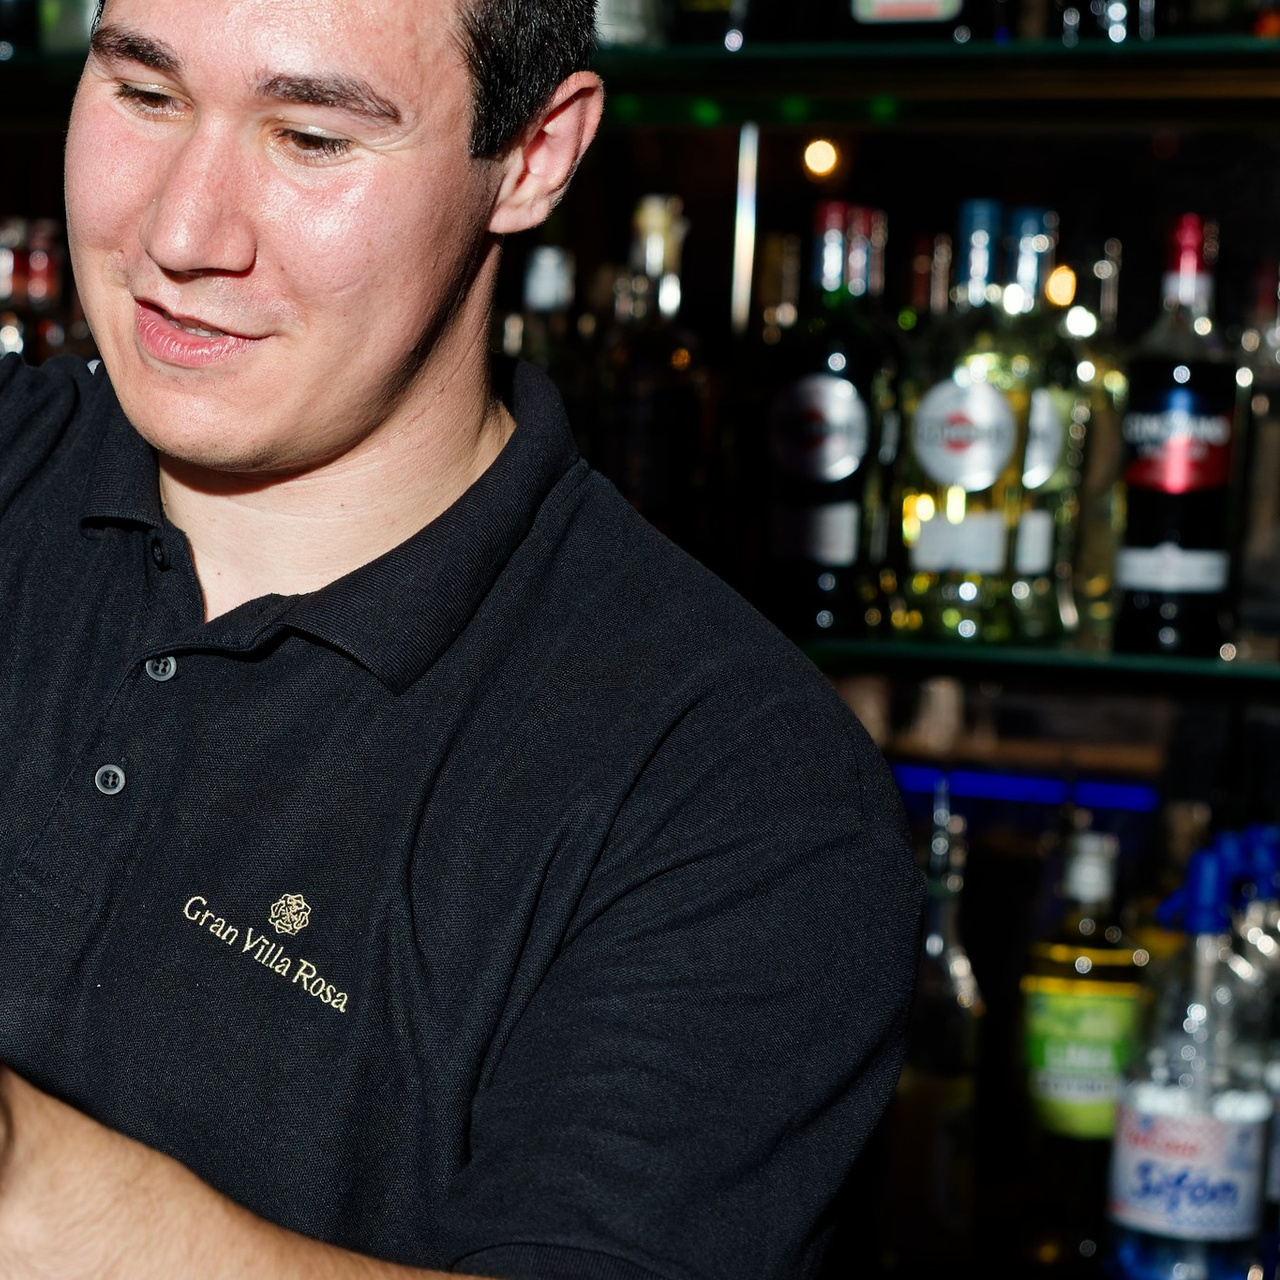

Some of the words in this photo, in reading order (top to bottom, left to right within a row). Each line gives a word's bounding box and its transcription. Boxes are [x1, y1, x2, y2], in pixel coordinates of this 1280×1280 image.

[182, 895, 239, 946] Gran
[241, 926, 292, 977] Villa
[291, 957, 349, 1014] Rosa
